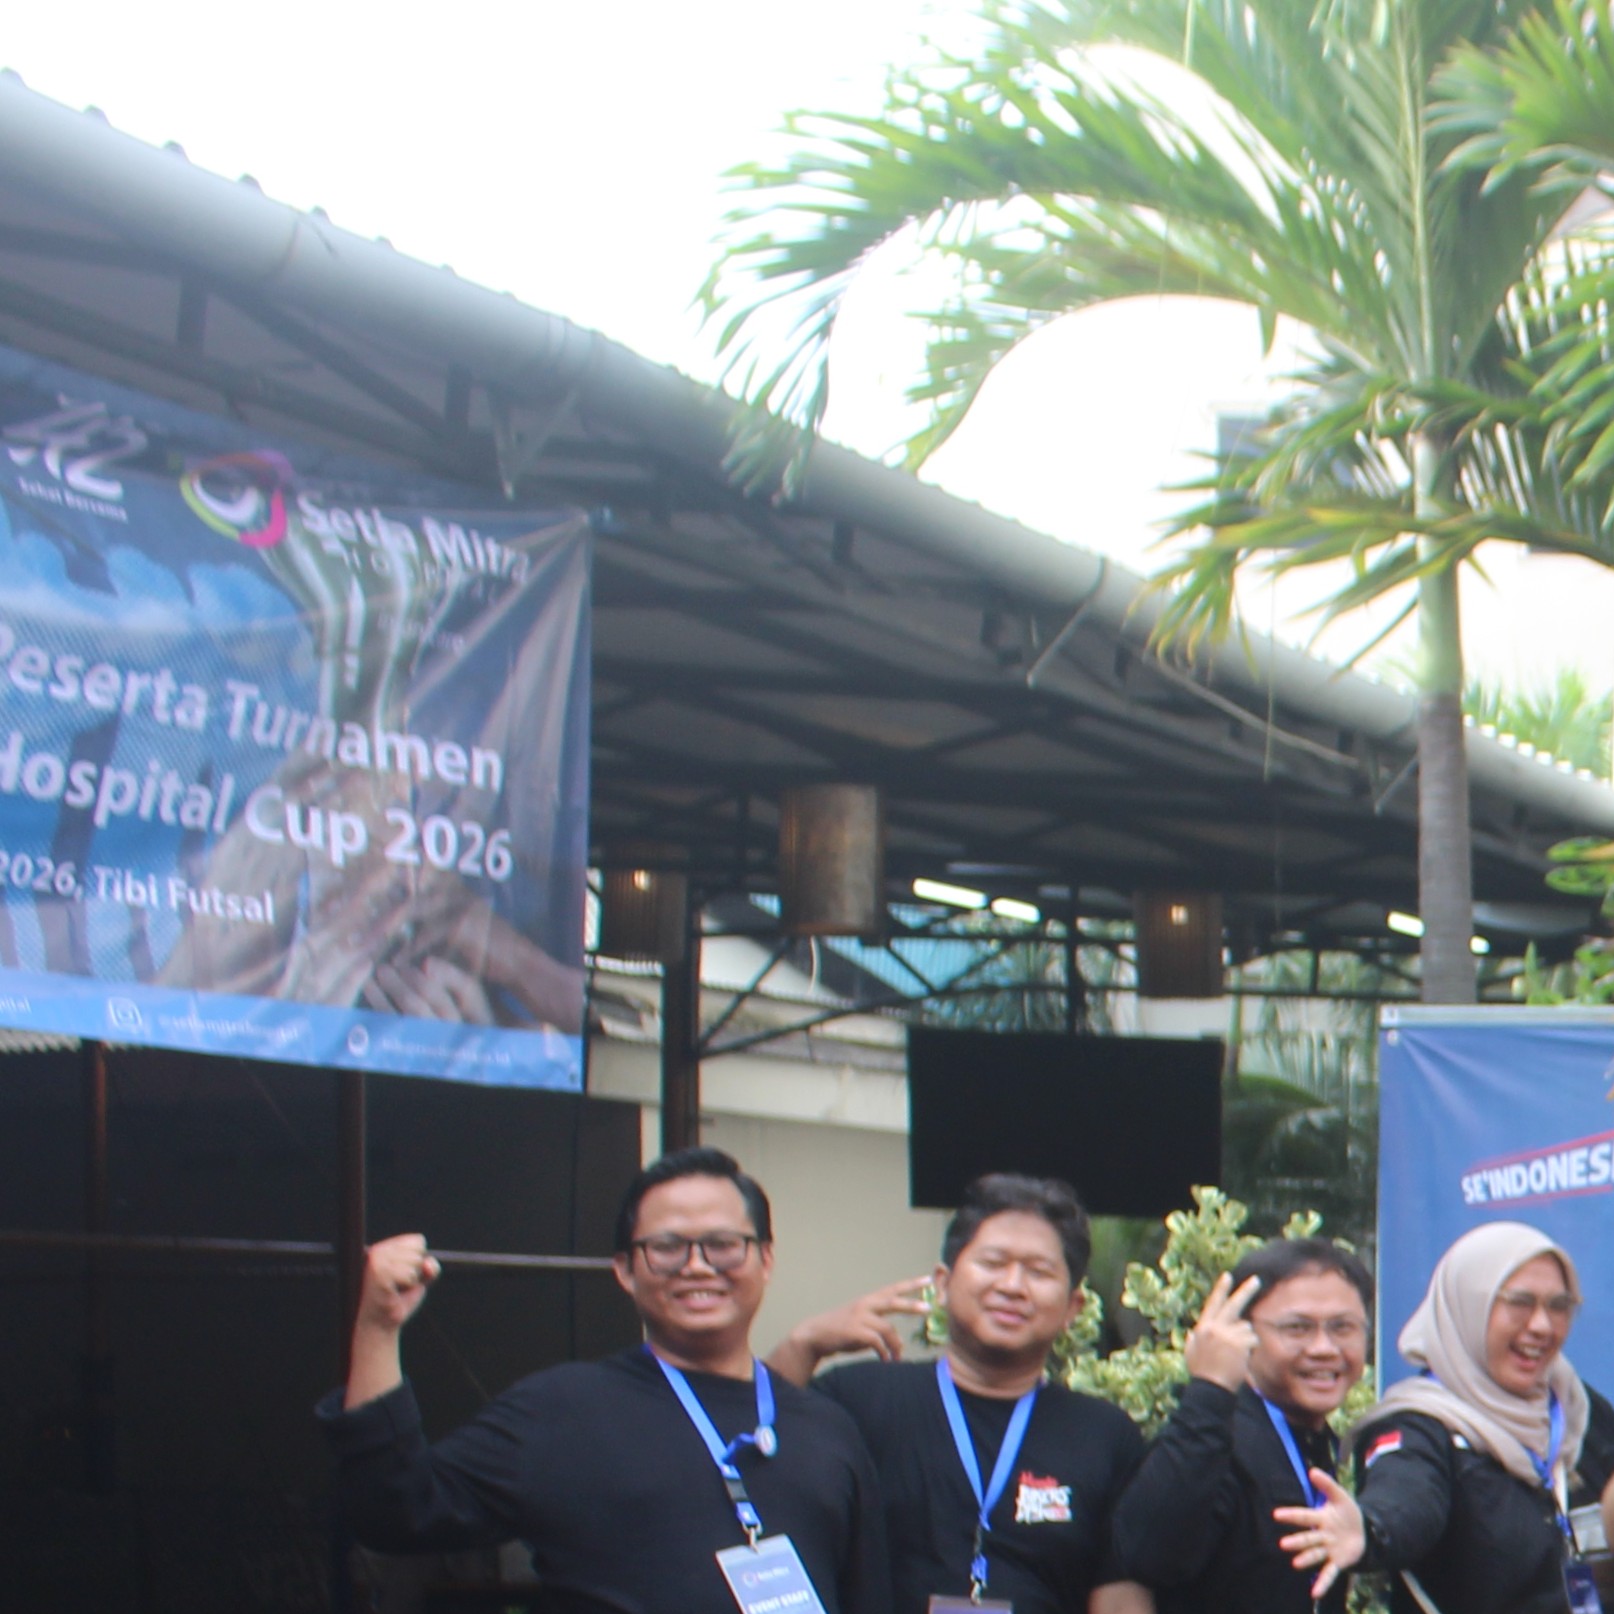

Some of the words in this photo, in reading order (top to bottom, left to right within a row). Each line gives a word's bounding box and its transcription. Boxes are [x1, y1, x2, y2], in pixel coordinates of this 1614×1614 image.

[226, 679, 504, 792] Turnamen
[244, 783, 368, 868] Cup
[383, 807, 513, 881] 2026
[168, 876, 276, 924] Futsal
